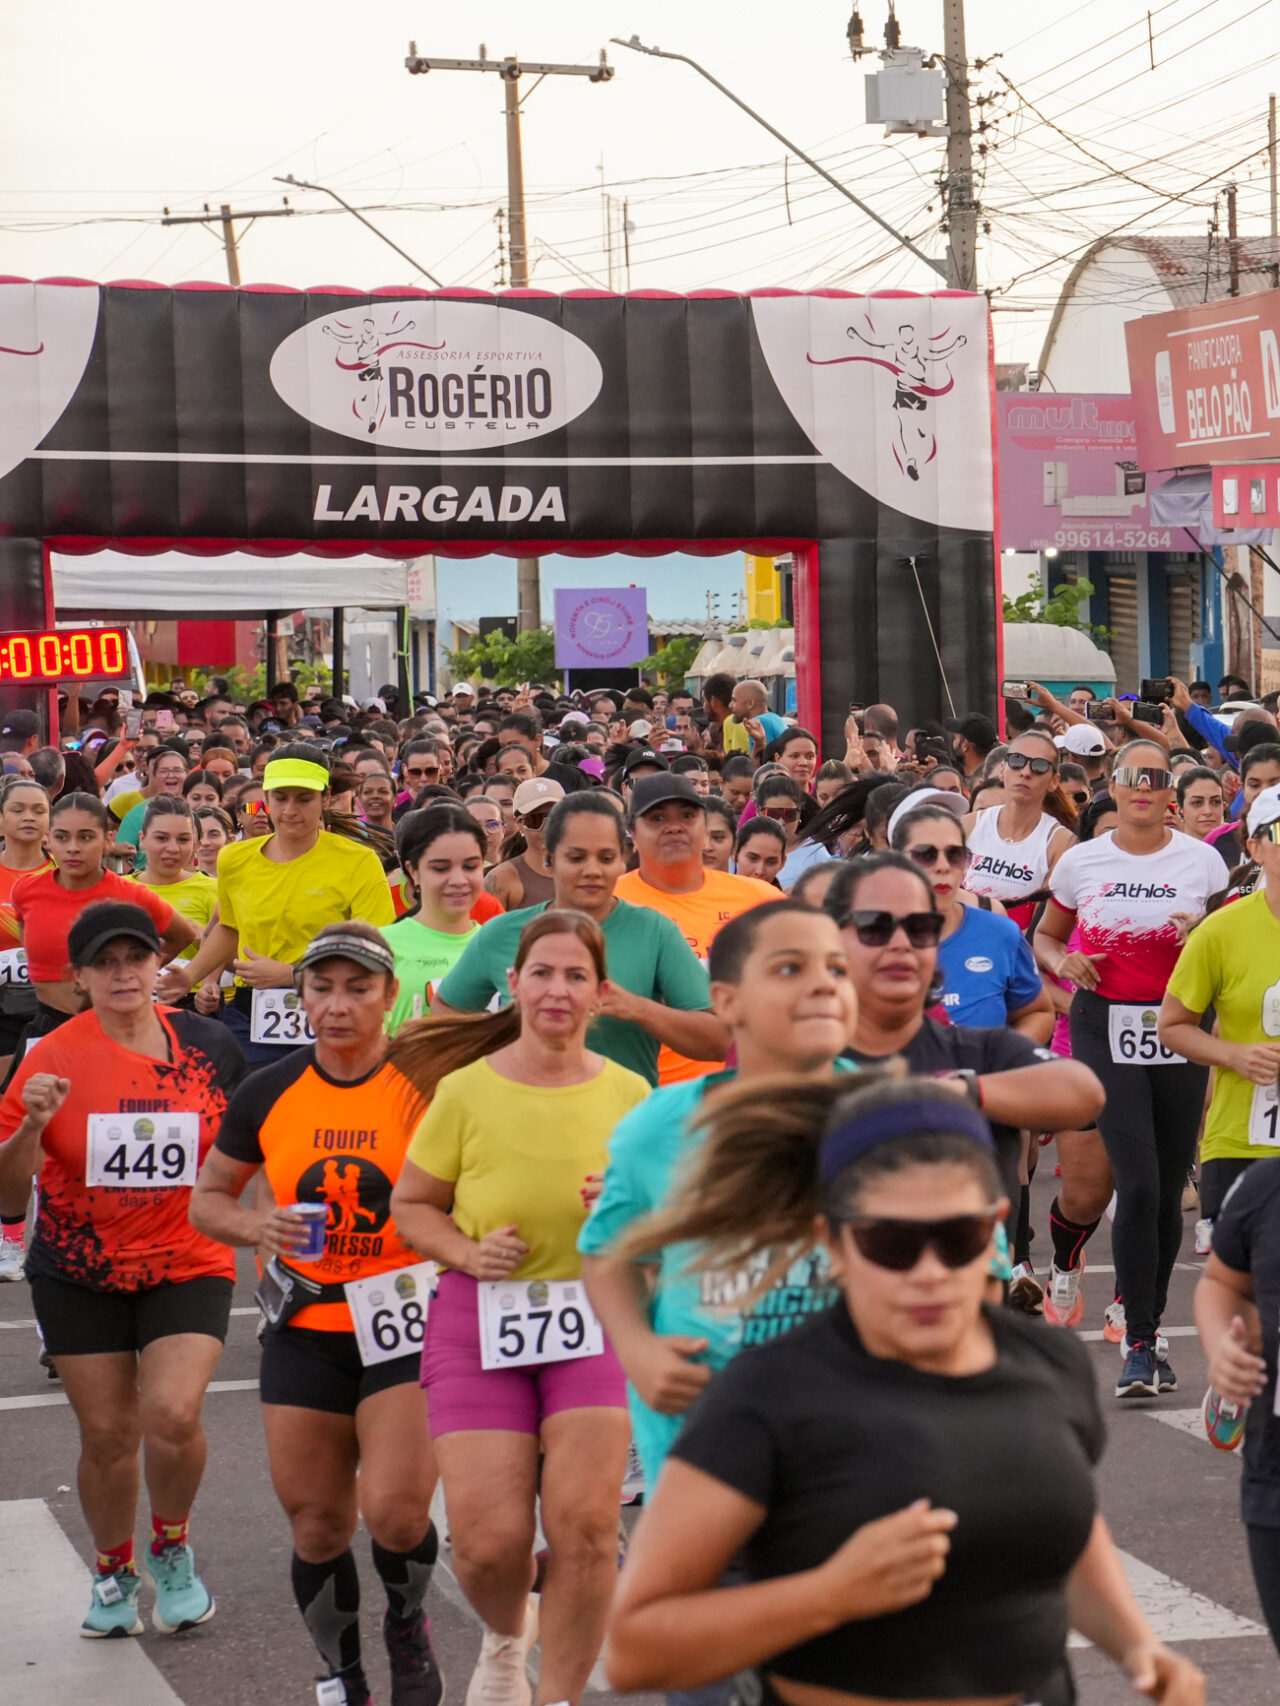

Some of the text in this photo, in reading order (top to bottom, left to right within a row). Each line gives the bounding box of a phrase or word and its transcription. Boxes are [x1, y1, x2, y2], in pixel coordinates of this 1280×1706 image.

[397, 350, 543, 361] ASSESSORIA ESPORTIVA
[1188, 334, 1242, 371] PANIFICADORA
[388, 365, 552, 420] ROGÉRIO
[1187, 385, 1222, 439] BELO
[1223, 367, 1252, 435] PÃO
[404, 420, 541, 430] CUSTELA
[313, 485, 566, 522] LARGADA
[1054, 530, 1172, 548] 99614-5264
[0, 632, 123, 678] :00:00
[313, 1129, 379, 1151] EQUIPE
[103, 1143, 186, 1180] 449
[153, 1193, 163, 1207] 6
[349, 1258, 361, 1274] 6
[499, 1306, 585, 1358] 579
